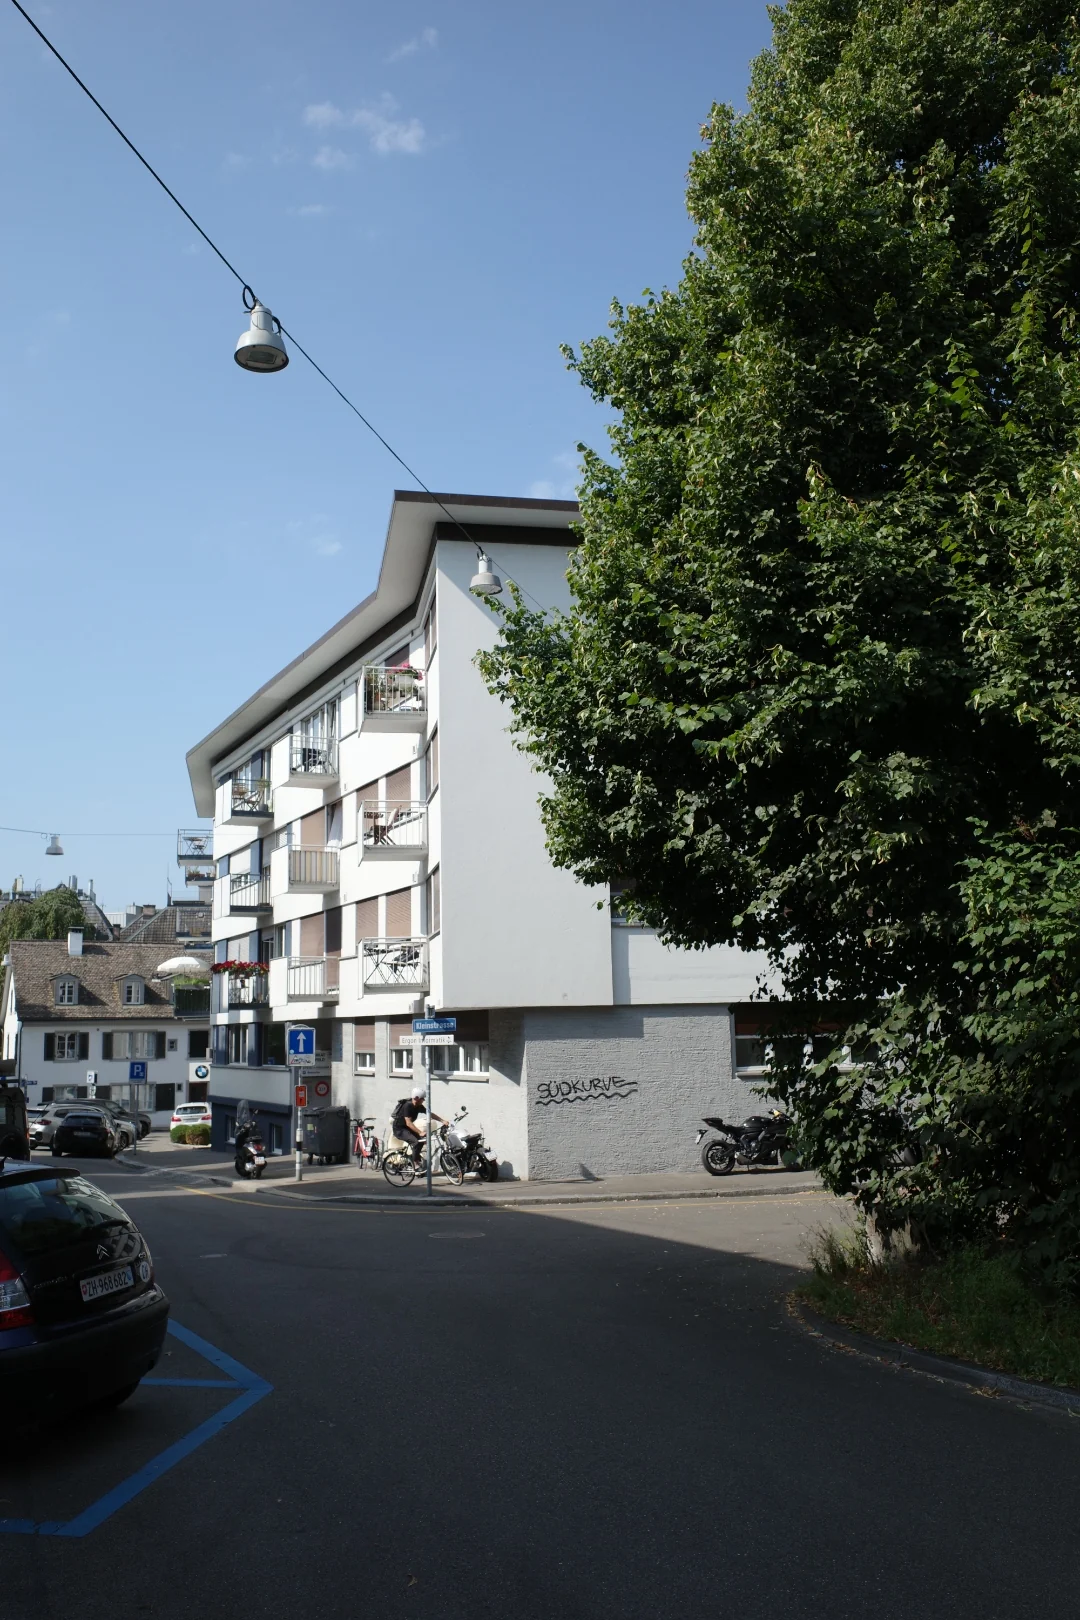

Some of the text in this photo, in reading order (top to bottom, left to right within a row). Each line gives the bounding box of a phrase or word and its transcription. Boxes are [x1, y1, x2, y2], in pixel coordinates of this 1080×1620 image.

[415, 1021, 454, 1030] Kleinstrasse
[401, 1037, 417, 1045] Ergon
[134, 1064, 142, 1076] P
[537, 1076, 638, 1099] SÜDKURVE
